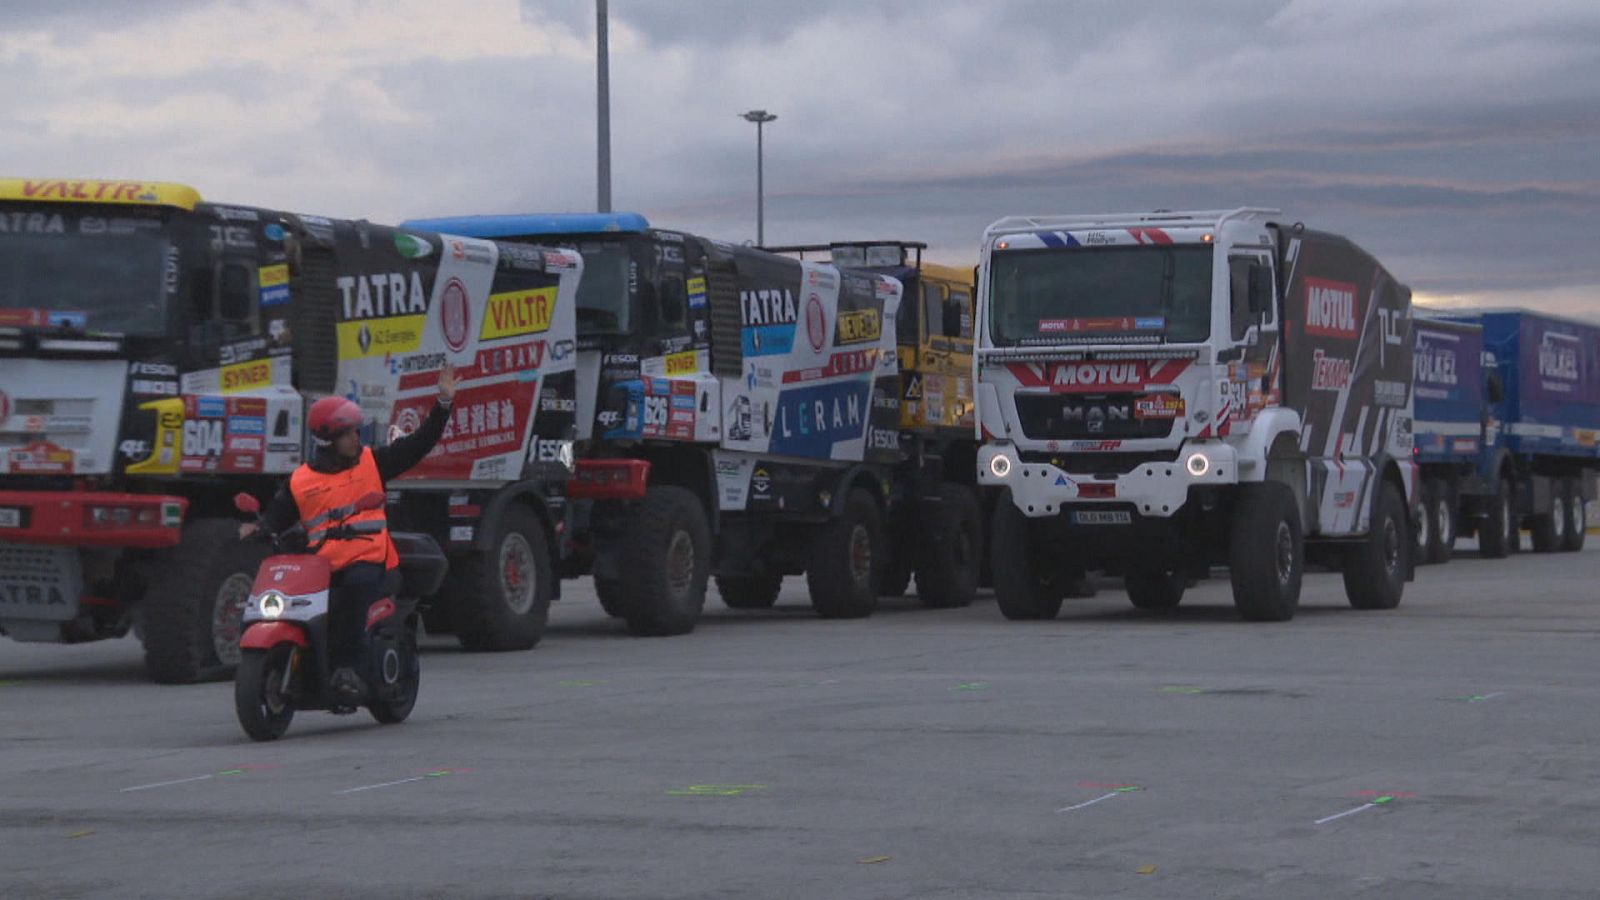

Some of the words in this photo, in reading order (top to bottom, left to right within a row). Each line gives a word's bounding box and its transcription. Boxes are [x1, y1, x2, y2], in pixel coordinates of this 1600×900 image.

[22, 181, 141, 200] VALTR
[337, 271, 426, 320] TATRA
[740, 288, 797, 325] TATRA
[1307, 285, 1355, 331] MOTUL
[490, 294, 549, 331] VALTR
[1041, 321, 1066, 330] MOTUL
[223, 364, 270, 389] SYNER
[666, 353, 696, 374] SYNER
[1053, 363, 1141, 385] MOTUL
[644, 395, 668, 427] 626
[780, 393, 860, 438] LERAM
[1063, 405, 1129, 420] MAN
[182, 419, 223, 457] 604
